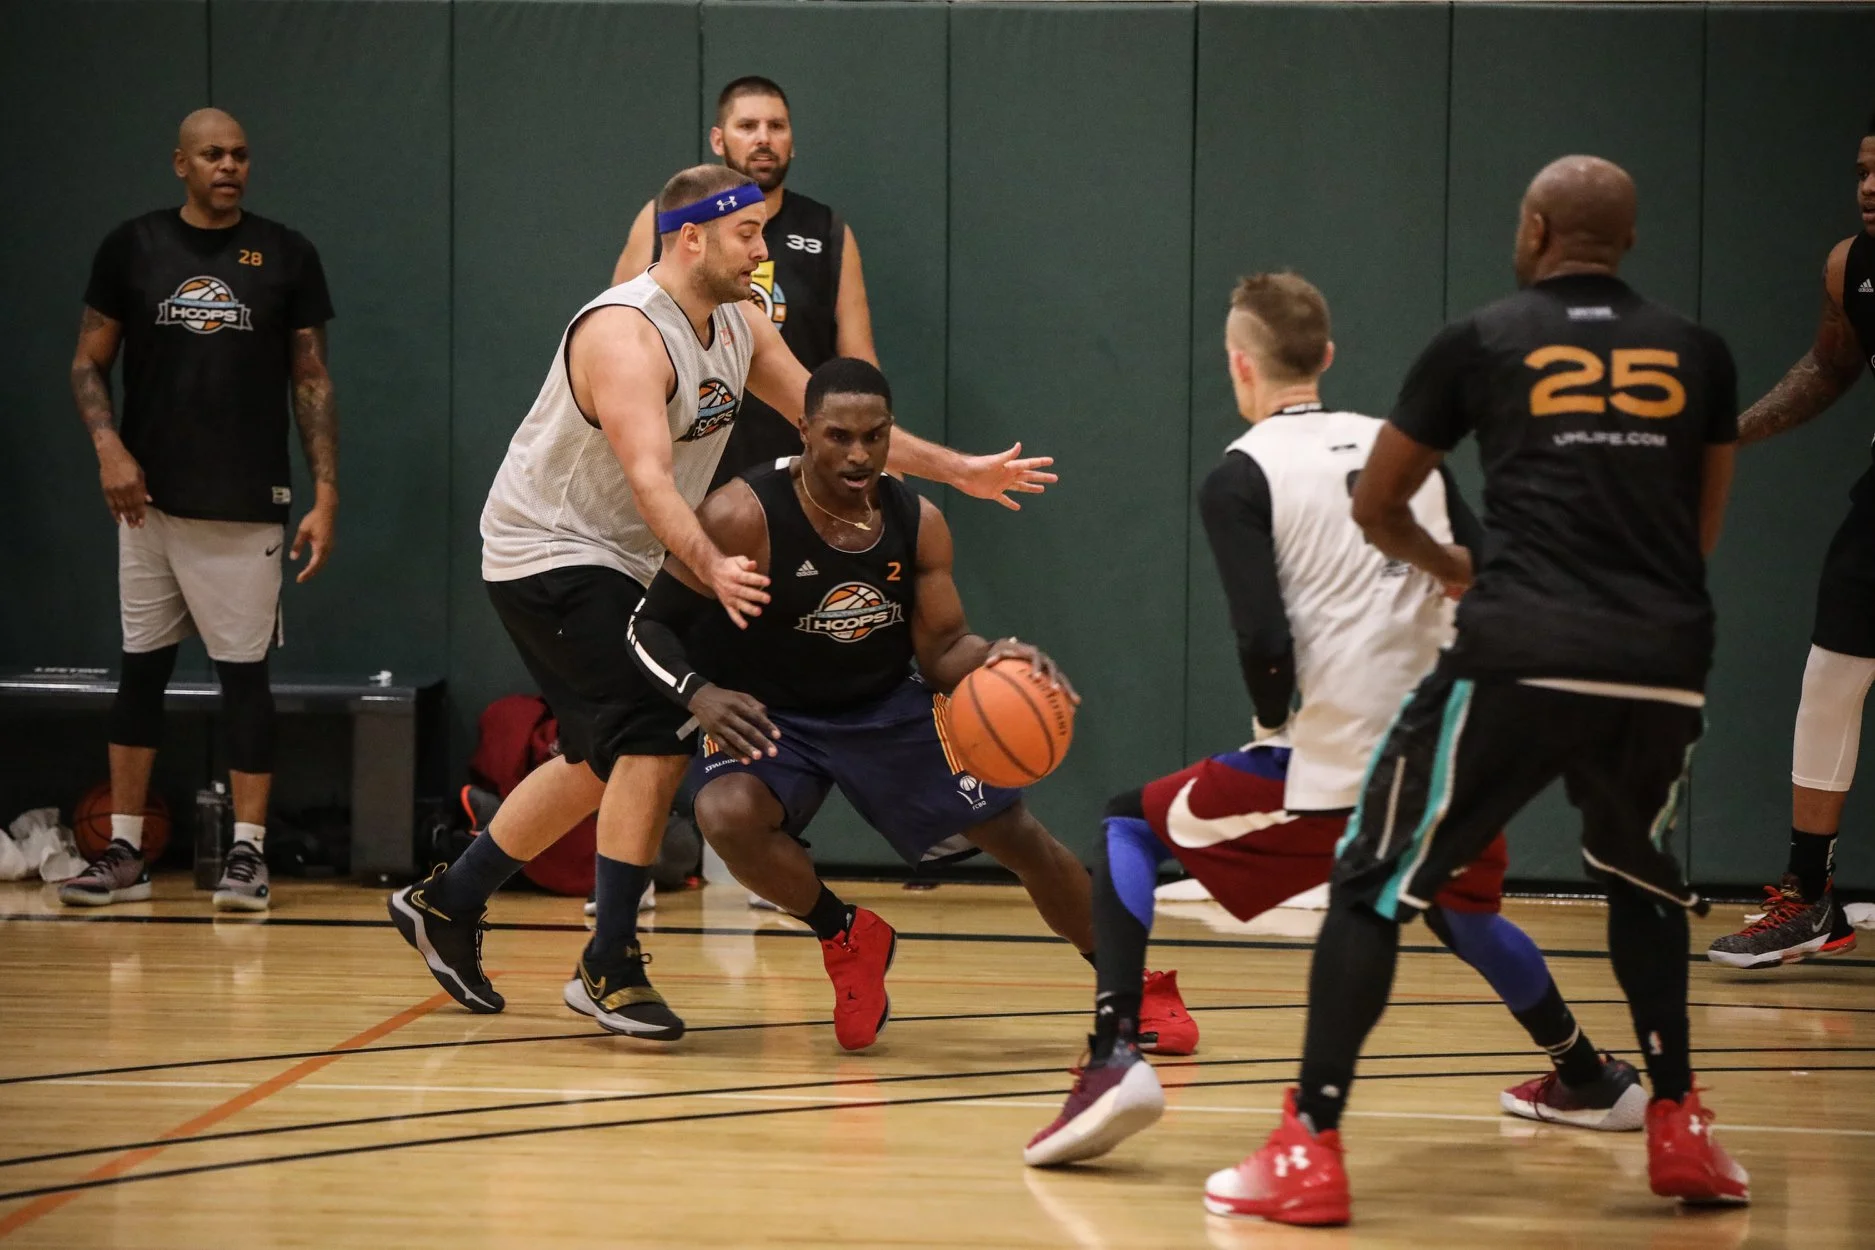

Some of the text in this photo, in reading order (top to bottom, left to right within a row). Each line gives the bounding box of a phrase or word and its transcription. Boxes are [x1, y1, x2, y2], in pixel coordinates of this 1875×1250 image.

[786, 234, 823, 254] 33
[239, 249, 263, 266] 28
[171, 306, 238, 322] HOOPS
[1523, 344, 1687, 418] 25
[886, 562, 902, 581] 2
[814, 611, 888, 630] HOOPS
[705, 758, 738, 774] SPALDIN
